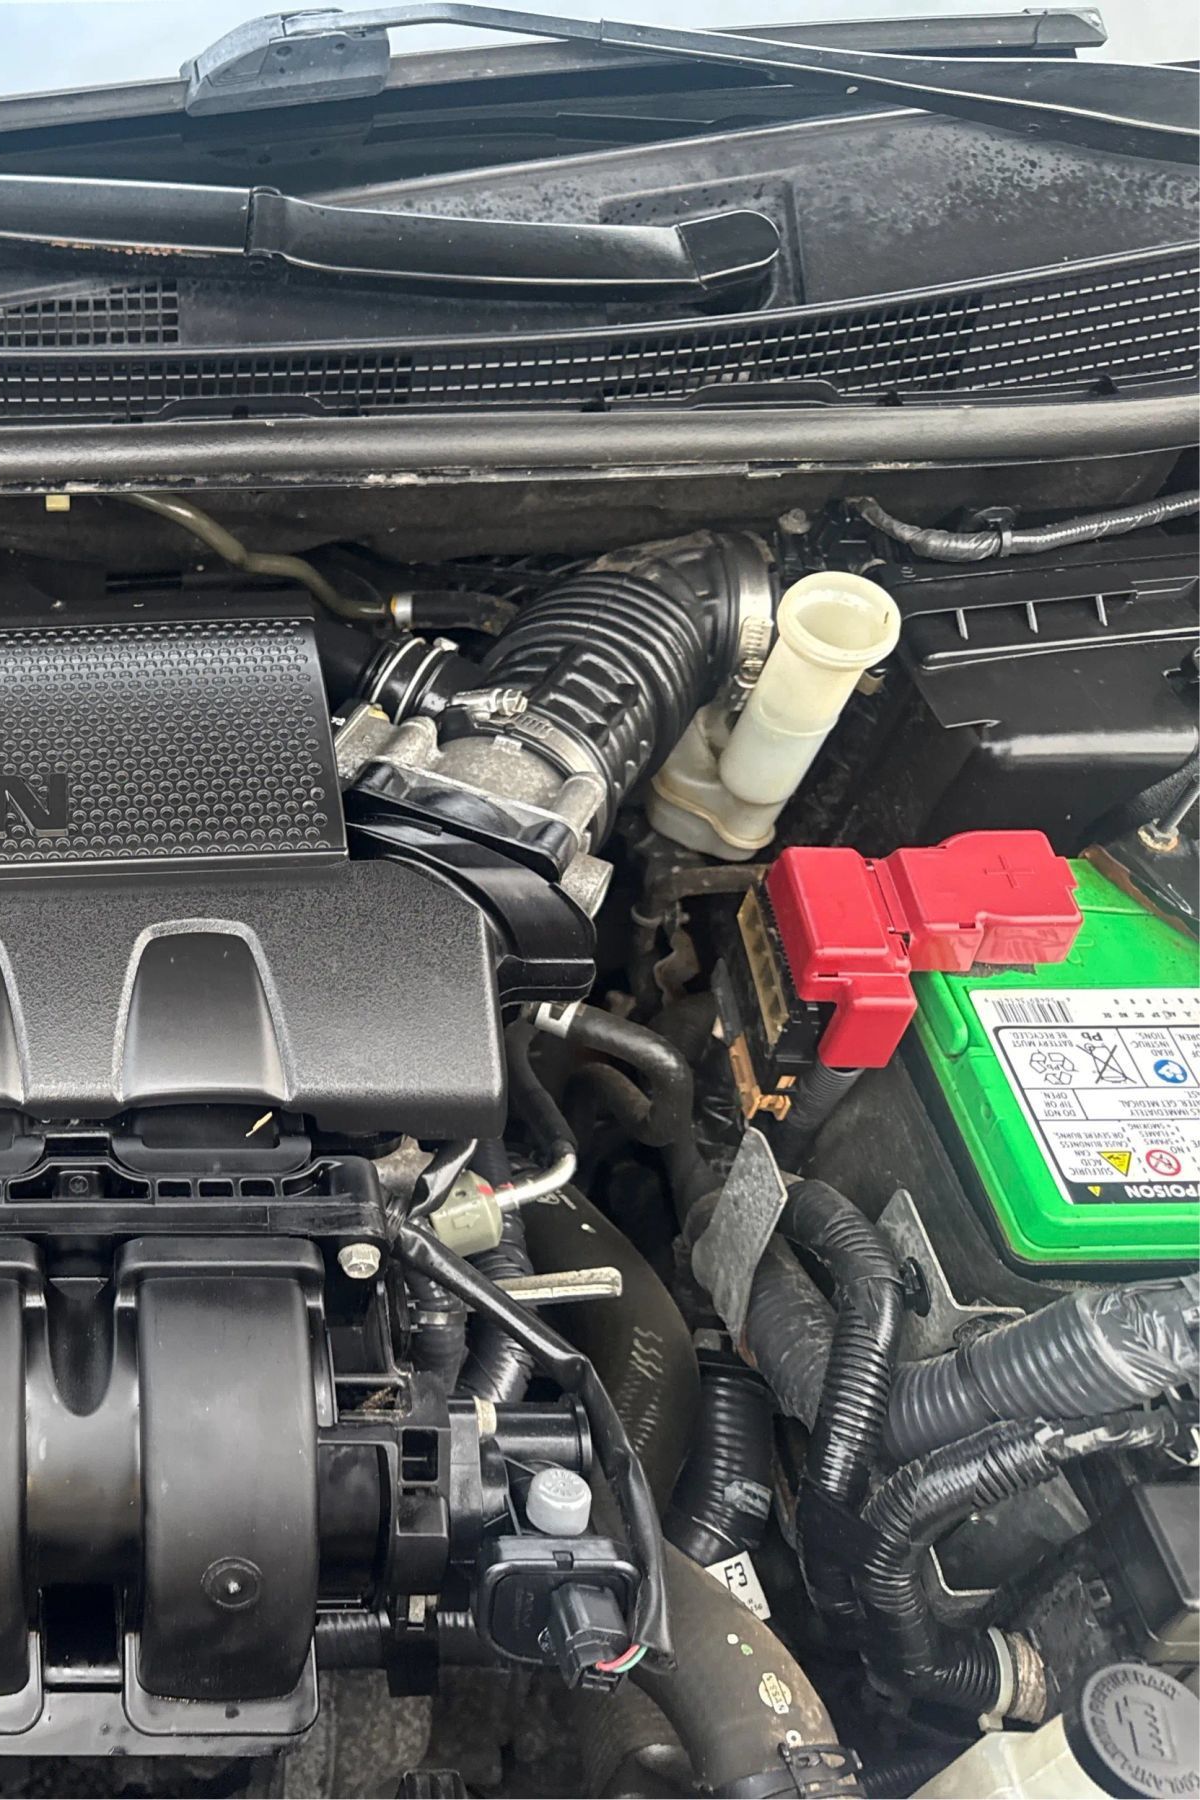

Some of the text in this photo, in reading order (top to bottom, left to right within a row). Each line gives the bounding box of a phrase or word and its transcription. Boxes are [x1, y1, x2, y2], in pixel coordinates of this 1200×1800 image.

[1081, 1032, 1103, 1041] Pb
[1044, 1109, 1061, 1117] NOT
[1170, 1146, 1185, 1154] NO
[724, 1561, 747, 1590] F3
